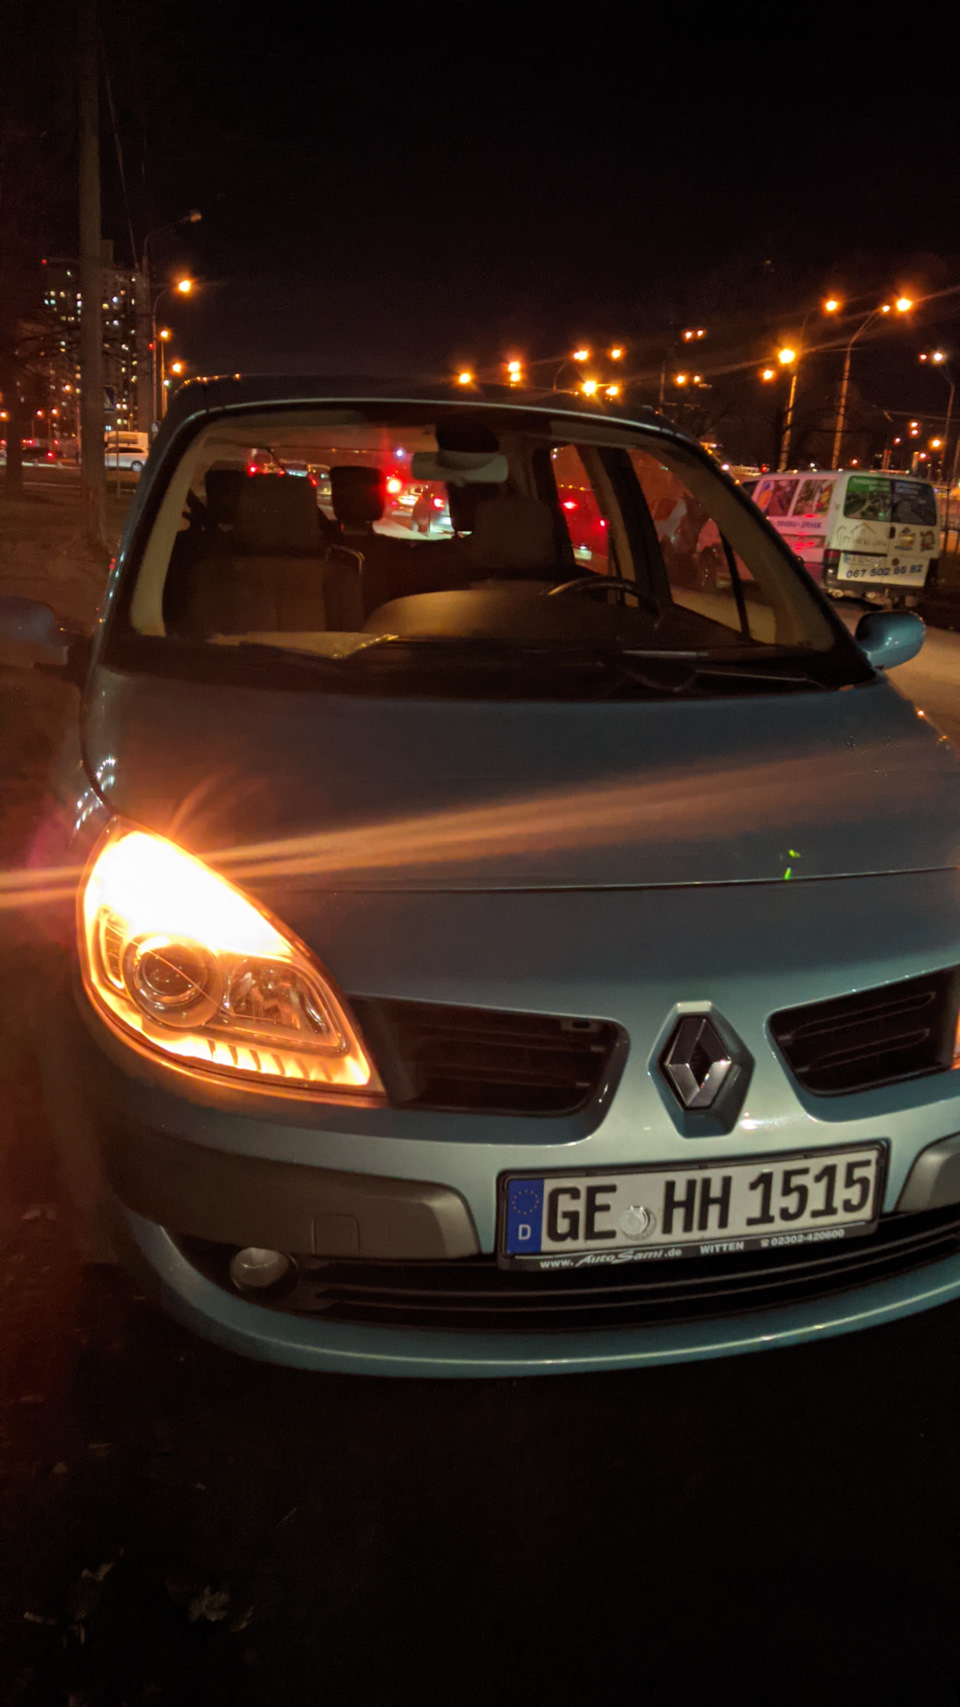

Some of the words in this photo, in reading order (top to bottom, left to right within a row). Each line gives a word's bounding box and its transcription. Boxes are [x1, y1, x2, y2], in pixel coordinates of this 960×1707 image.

[846, 569, 867, 578] 067
[870, 567, 891, 577] 502
[545, 1184, 617, 1243] GE
[661, 1175, 733, 1235] HH
[746, 1159, 873, 1226] 1515
[517, 1223, 532, 1241] D
[699, 1241, 745, 1255] WITTEN
